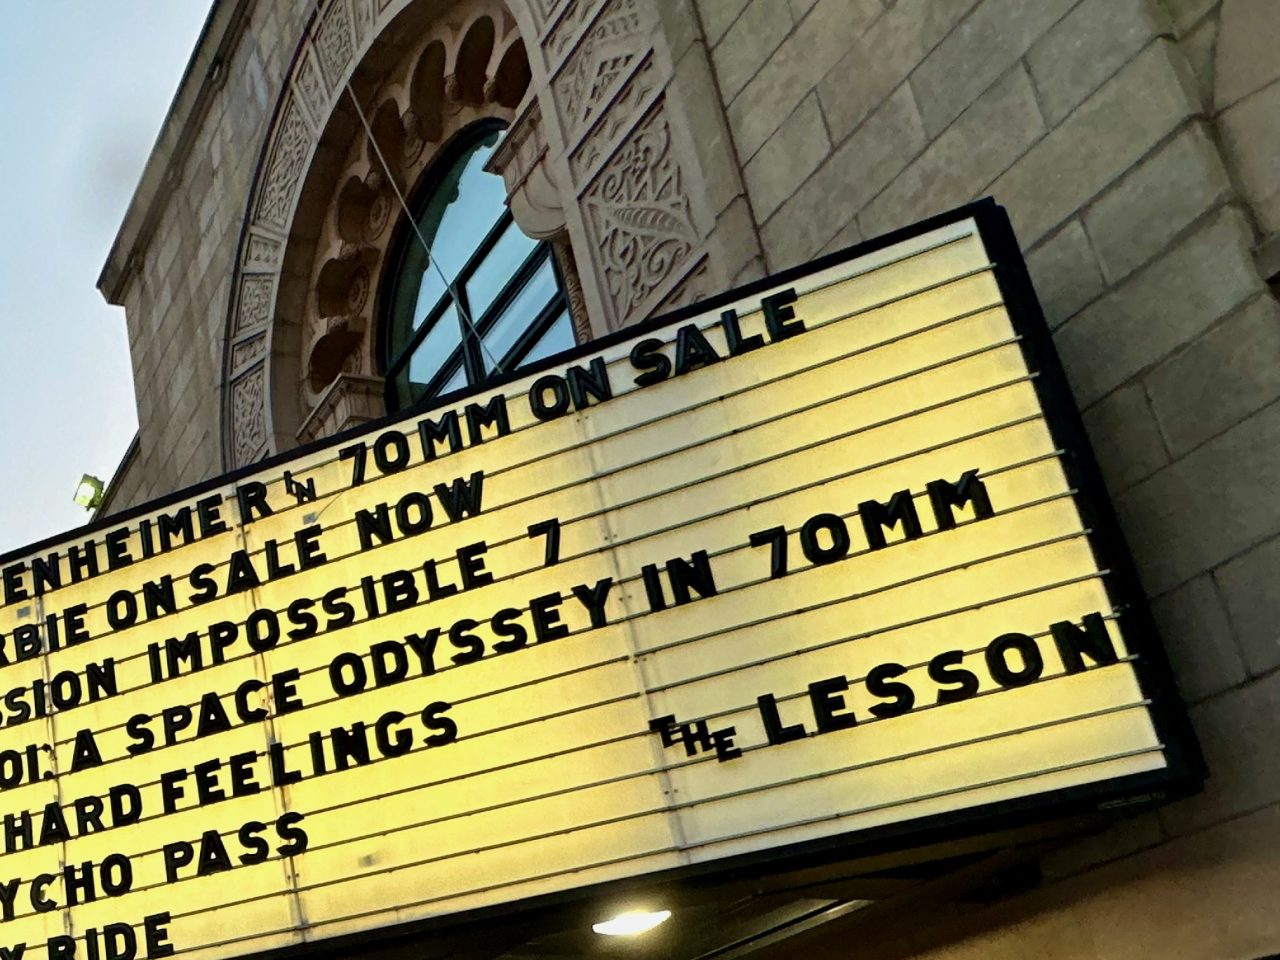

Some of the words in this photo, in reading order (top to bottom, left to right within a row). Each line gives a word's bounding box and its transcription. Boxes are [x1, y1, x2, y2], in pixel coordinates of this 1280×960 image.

[338, 393, 511, 487] 70MM
[528, 356, 614, 422] ON
[630, 287, 808, 388] SALE
[70, 728, 104, 773] A
[126, 668, 304, 755] SPACE
[328, 577, 614, 697] ODYSSEY
[641, 549, 718, 613] IN
[749, 468, 996, 578] 70MM
[106, 574, 177, 633] ON
[188, 524, 327, 606] SALE
[355, 470, 484, 551] NOW
[147, 541, 495, 684] IMPOSSIBLE
[527, 517, 561, 567] 7
[649, 713, 743, 763] THE
[757, 611, 1119, 745] LESSON
[4, 783, 143, 854] HARD
[161, 701, 458, 815] FEELINGS
[163, 811, 309, 883] PASS
